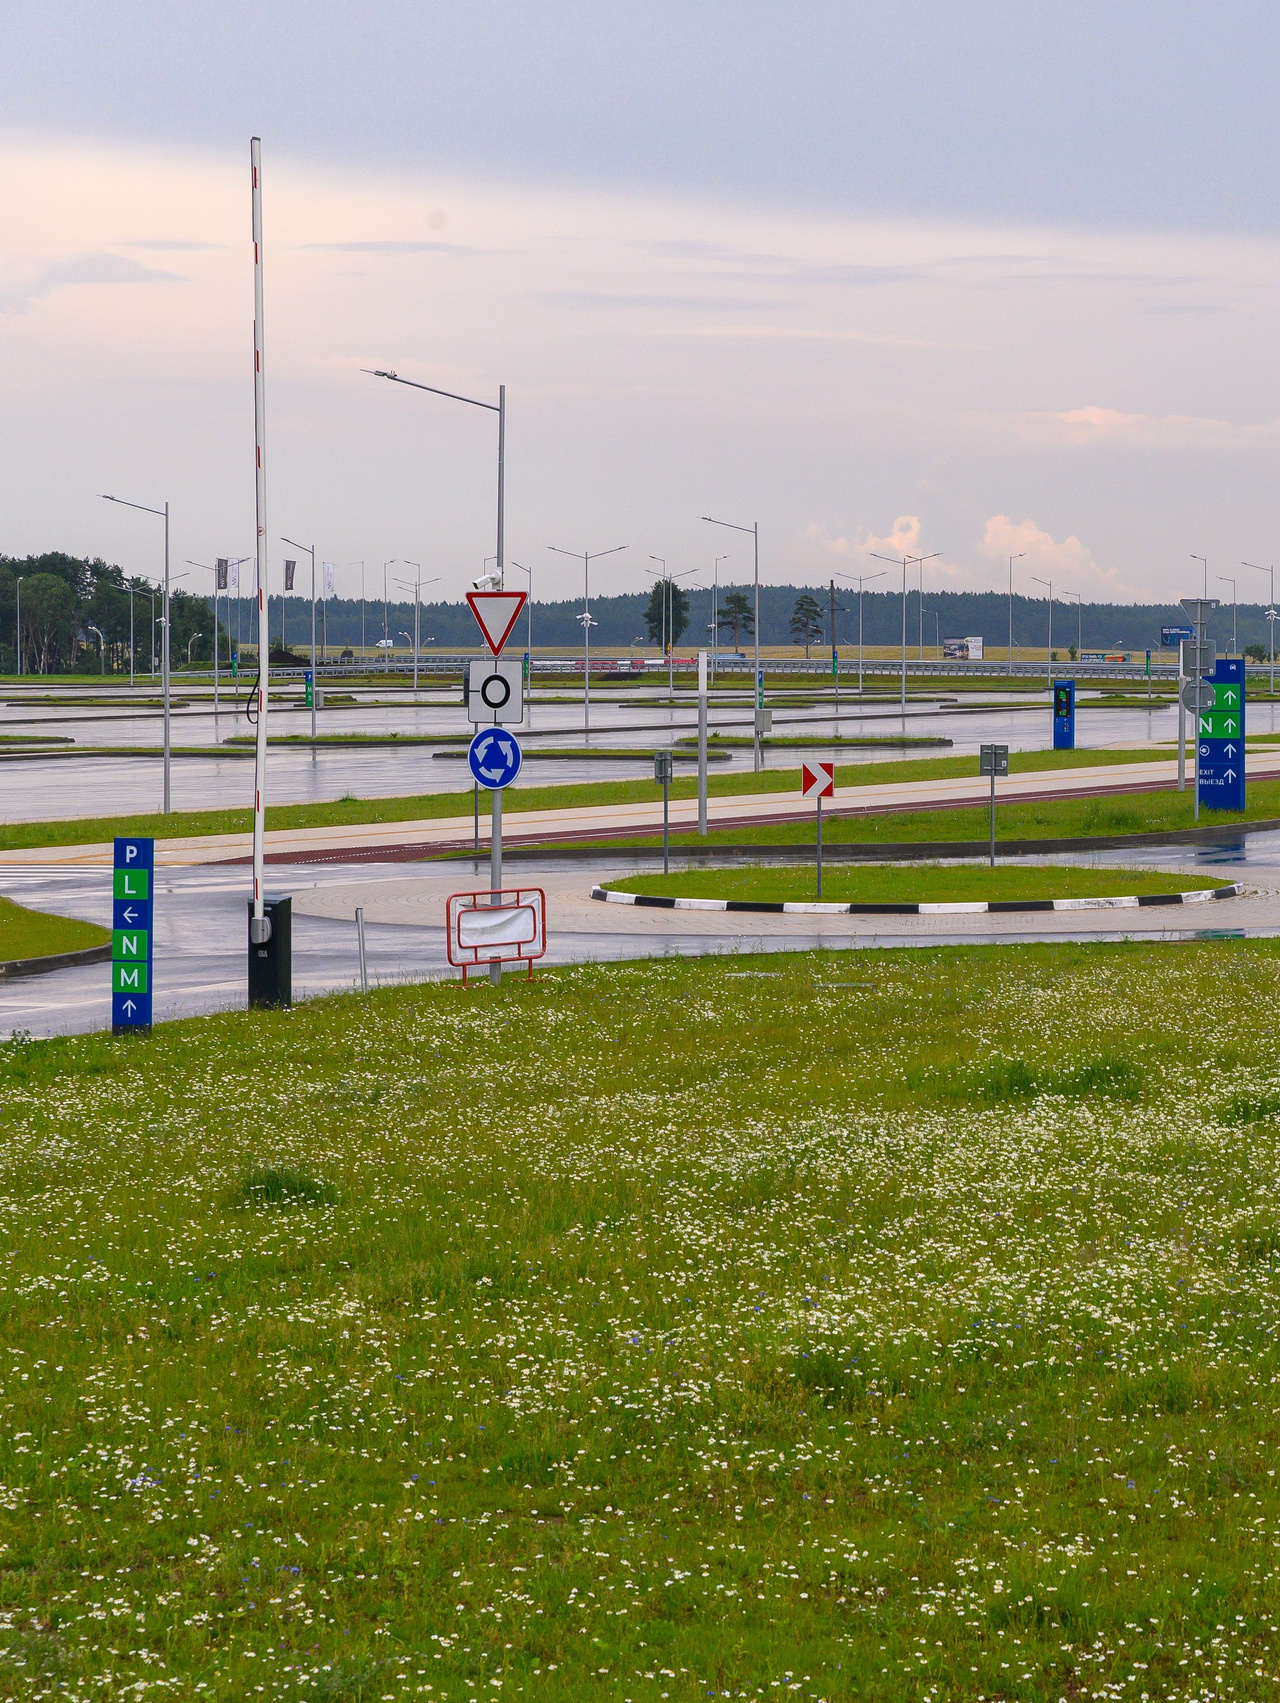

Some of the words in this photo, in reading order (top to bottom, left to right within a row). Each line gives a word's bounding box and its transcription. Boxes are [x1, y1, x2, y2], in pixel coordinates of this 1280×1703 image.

[1199, 717, 1212, 734] N
[126, 846, 138, 863] P
[124, 875, 136, 894] L
[122, 936, 138, 955] N
[120, 968, 138, 987] M
